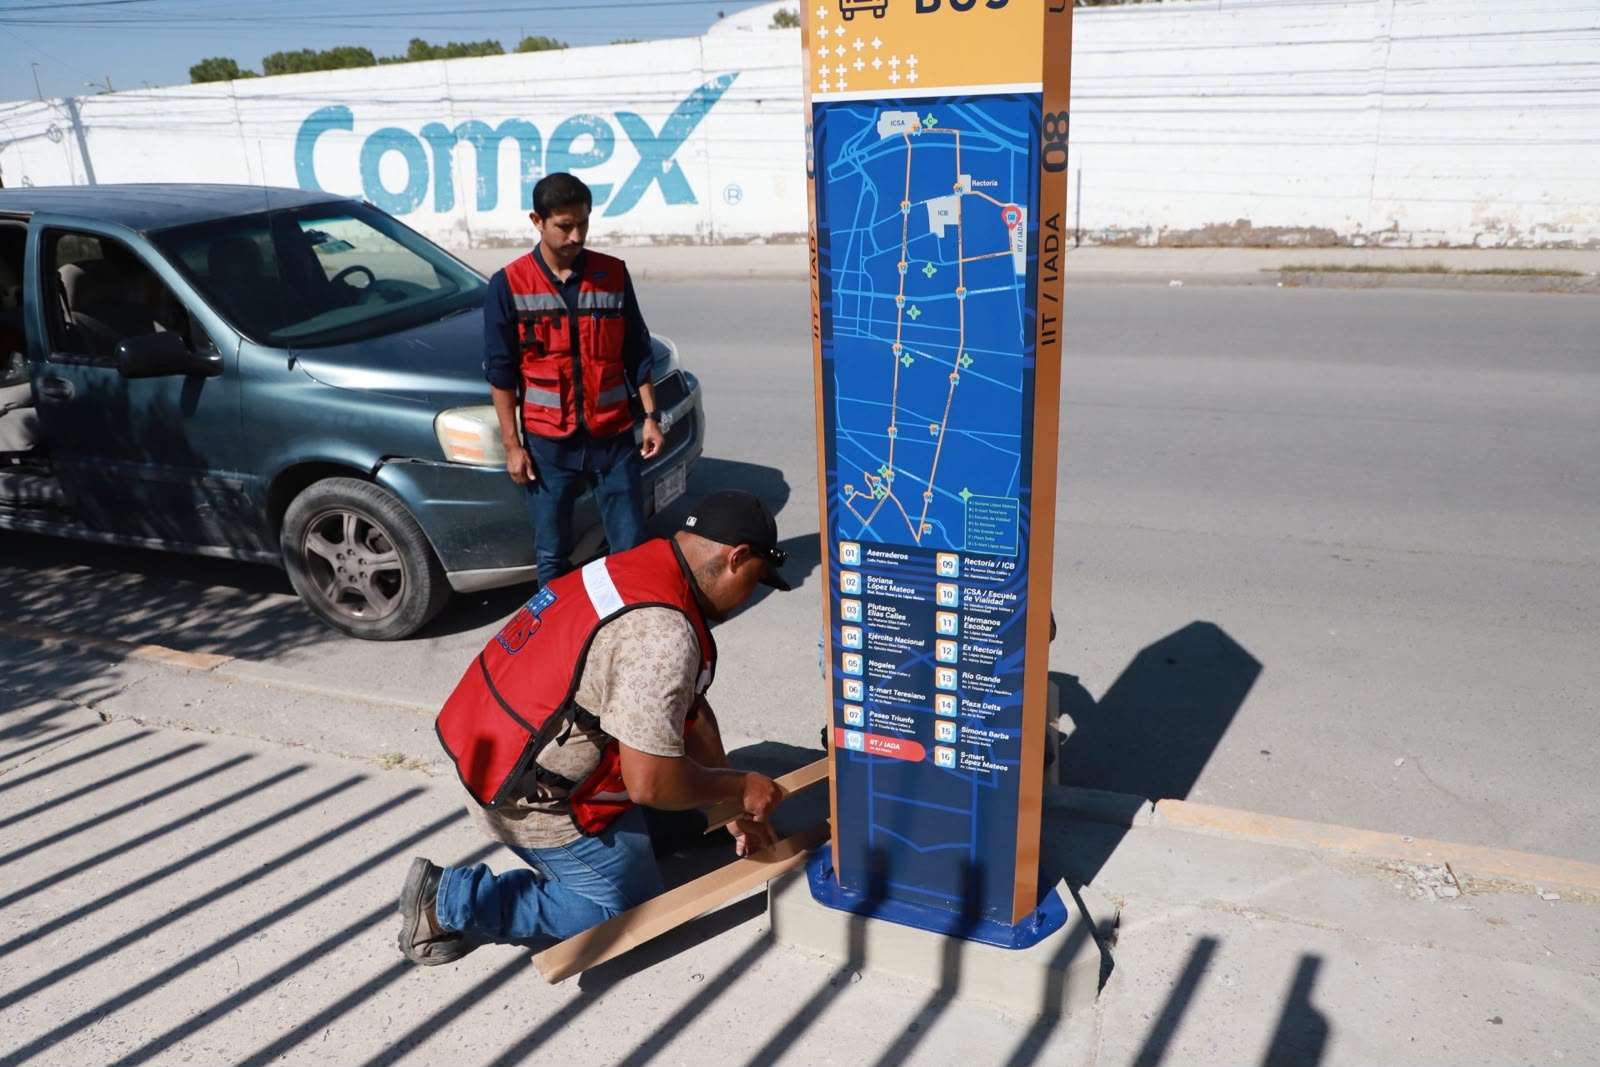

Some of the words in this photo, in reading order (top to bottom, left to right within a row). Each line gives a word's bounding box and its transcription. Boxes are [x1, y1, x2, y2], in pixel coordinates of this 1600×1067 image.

[294, 72, 740, 217] Comex
[1042, 111, 1070, 173] 08
[1044, 212, 1060, 283] IADA
[1043, 291, 1058, 303] /
[1041, 312, 1057, 346] IIT
[866, 549, 908, 560] Aserraderos
[942, 560, 953, 568] 09
[964, 558, 994, 568] Rectoría
[867, 576, 894, 584] Soriana
[867, 582, 888, 592] López
[889, 584, 915, 594] Mateos
[943, 590, 952, 598] 10
[964, 588, 982, 596] ICSA
[988, 590, 1016, 600] Escuela
[974, 596, 1004, 606] Vialidad
[868, 602, 896, 612] Plutarco
[886, 612, 906, 620] Calles
[964, 616, 1000, 626] Hermanos
[943, 618, 952, 626] 11
[964, 622, 992, 632] Escobar
[894, 636, 924, 646] Nacional
[942, 647, 952, 655] 12
[973, 645, 1002, 656] Rectoría
[868, 660, 896, 670] Nogales
[976, 674, 1000, 684] Grande
[869, 685, 892, 694] S-mart
[894, 689, 926, 700] Teresiano
[942, 700, 950, 708] 14
[962, 700, 982, 708] Plaza
[982, 702, 1000, 711] Delta
[870, 710, 890, 719] Paseo
[891, 714, 914, 724] Triunfo
[942, 727, 950, 735] 15
[961, 726, 988, 736] Simona
[988, 730, 1010, 740] Barba
[942, 752, 950, 760] 16
[960, 752, 984, 761] S-mart
[960, 758, 982, 766] López
[982, 762, 1008, 772] Mateos
